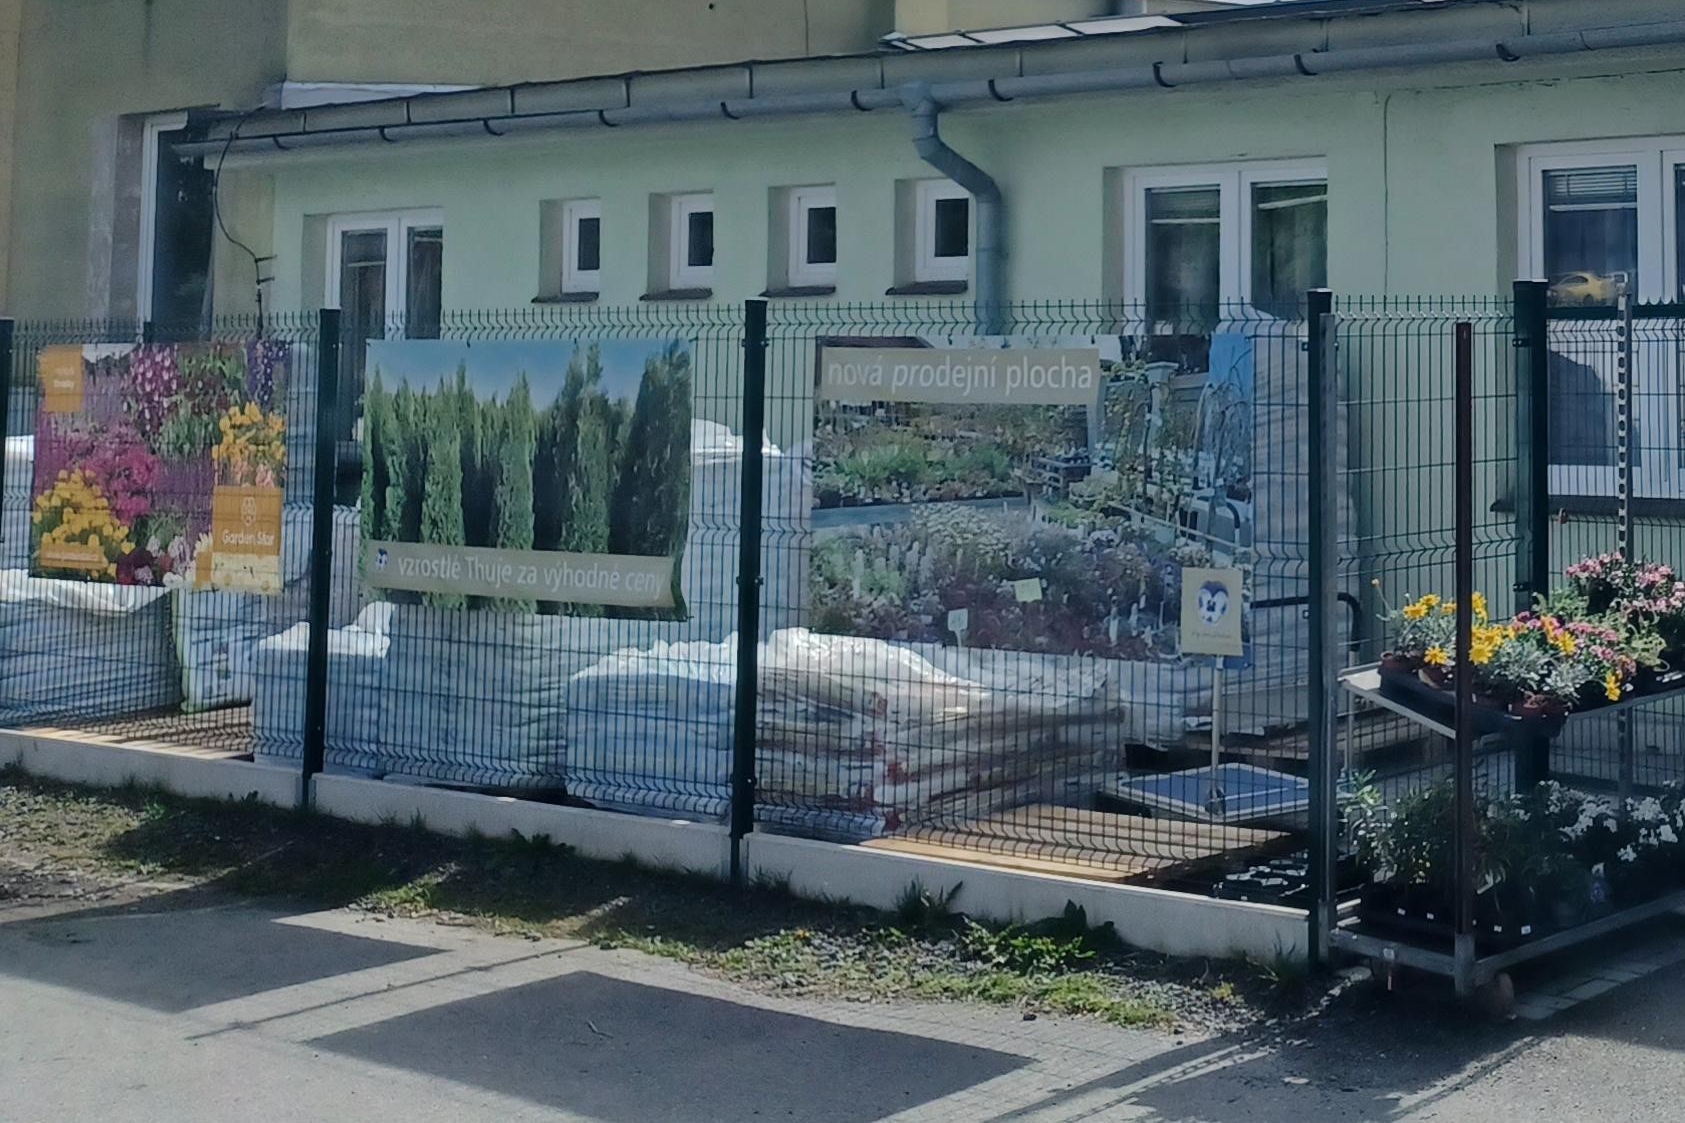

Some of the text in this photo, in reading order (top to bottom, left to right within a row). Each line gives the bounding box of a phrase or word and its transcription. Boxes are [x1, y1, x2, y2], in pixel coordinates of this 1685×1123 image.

[828, 356, 1092, 396] nová prodejní plocha
[398, 555, 665, 600] vzrostlé Thuje za výhodné ceny
